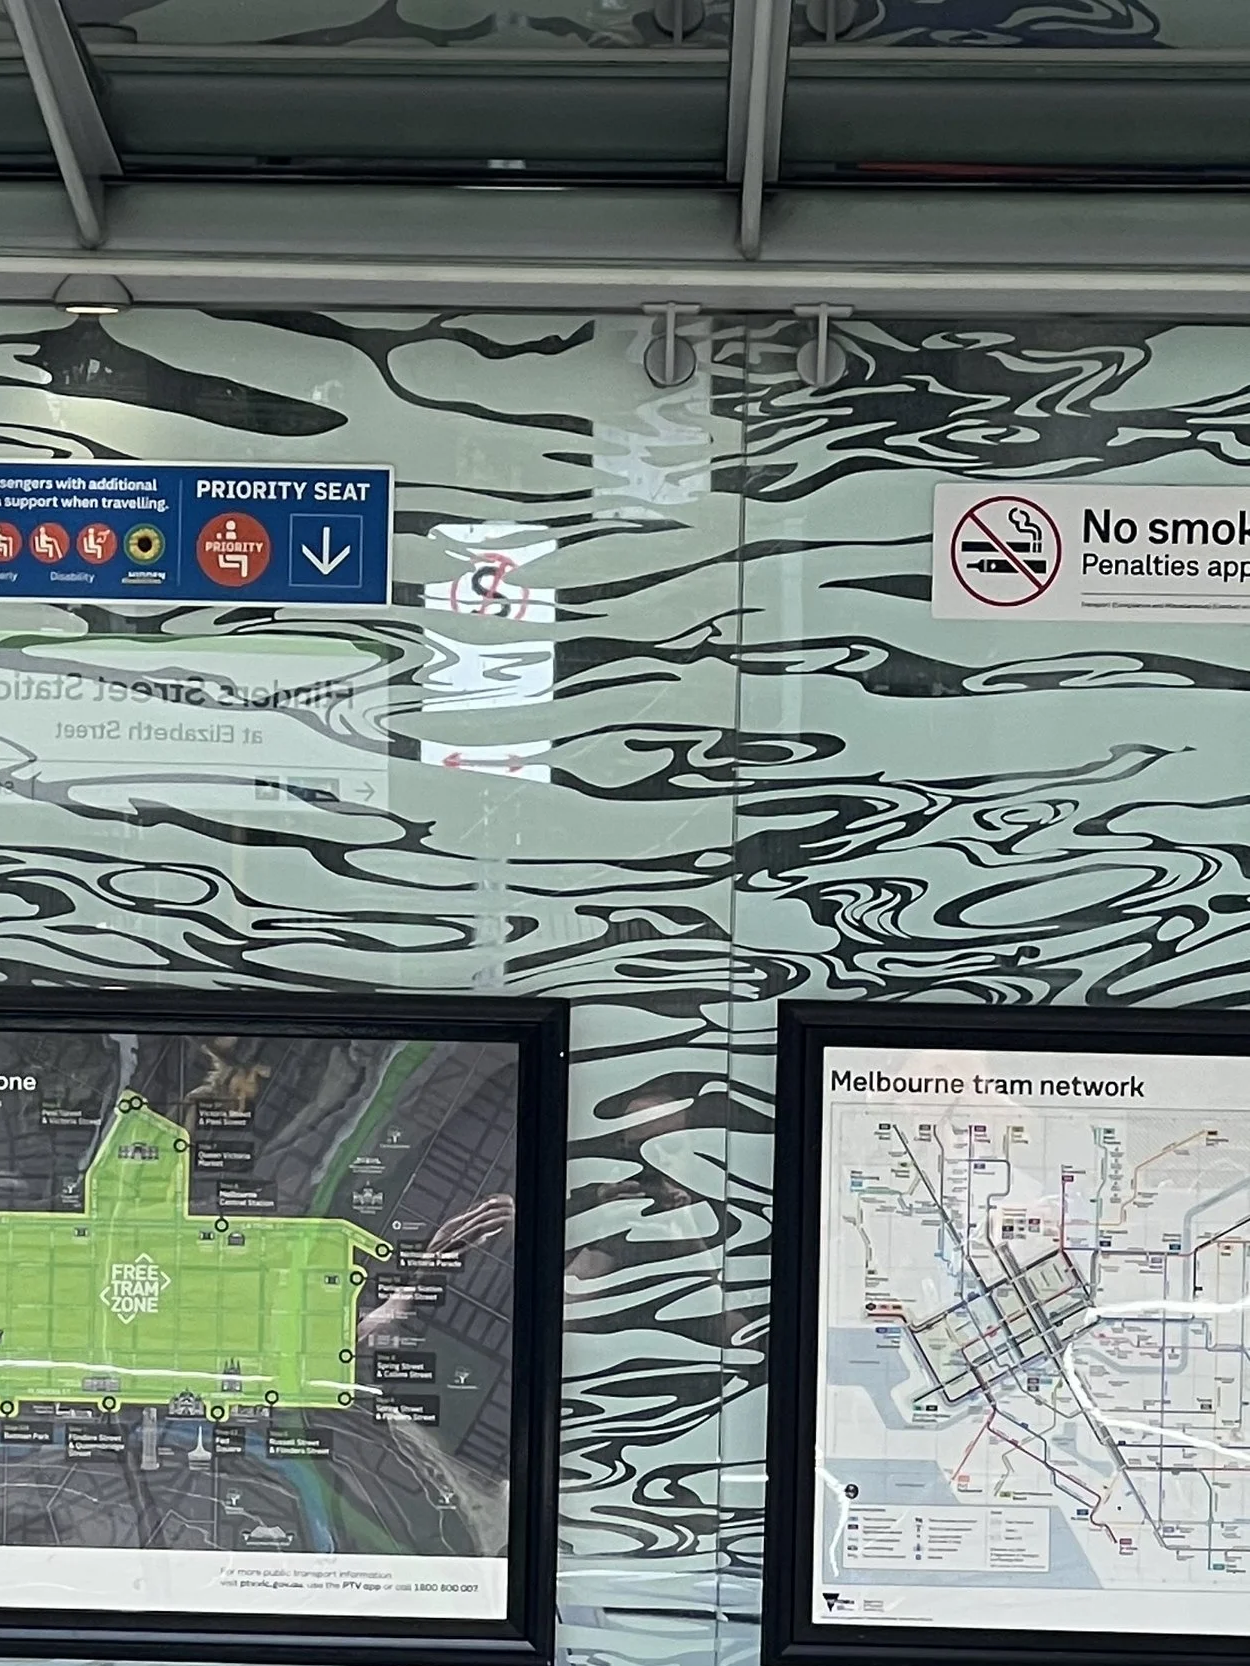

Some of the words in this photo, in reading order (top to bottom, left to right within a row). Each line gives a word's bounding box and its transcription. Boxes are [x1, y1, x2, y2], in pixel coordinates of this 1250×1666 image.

[56, 477, 86, 490] with
[88, 478, 158, 492] additional
[197, 480, 307, 500] PRIORITY
[314, 482, 370, 501] SEAT
[4, 496, 58, 510] support
[61, 496, 98, 509] when
[101, 497, 169, 512] travelling.
[1083, 509, 1137, 543] No
[205, 541, 263, 553] PRIORITY
[1082, 553, 1199, 577] Penalties
[1208, 560, 1250, 582] app
[50, 571, 95, 583] Disability
[831, 1071, 964, 1093] Melbourne
[973, 1074, 1033, 1095] tram
[1040, 1076, 1145, 1097] network
[111, 1264, 159, 1280] FREE
[111, 1280, 159, 1296] TRAM
[111, 1296, 159, 1313] ZONE
[342, 1581, 361, 1589] PTV
[414, 1584, 438, 1592] 1800
